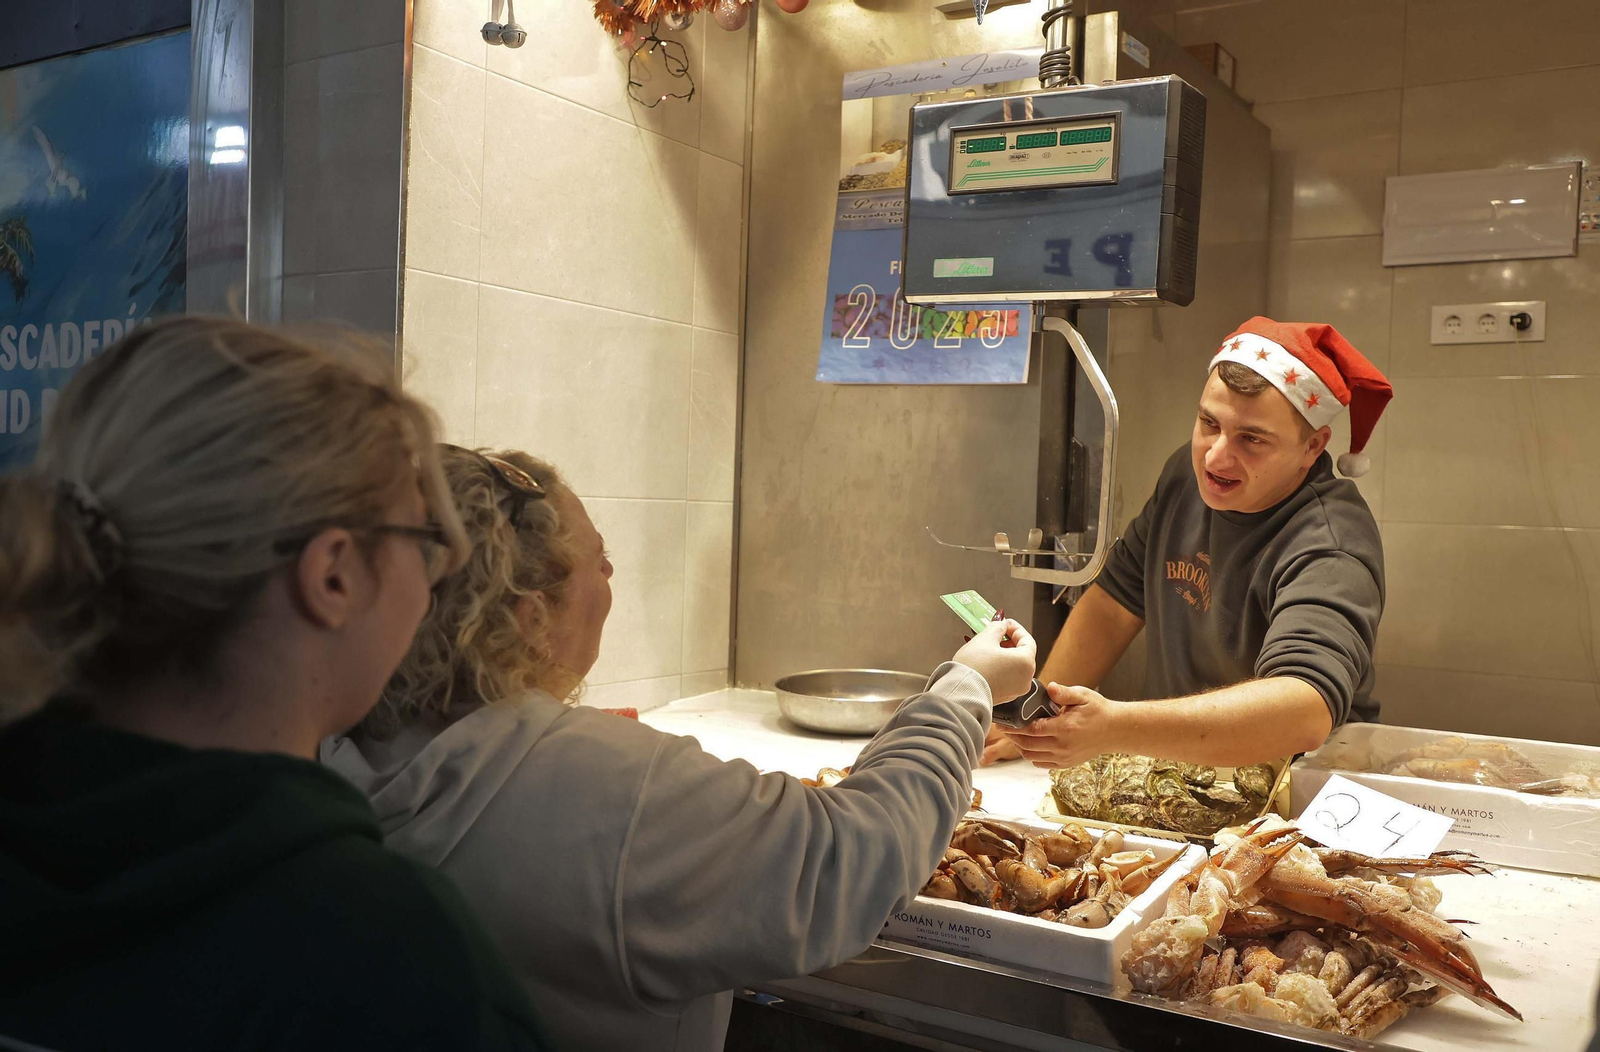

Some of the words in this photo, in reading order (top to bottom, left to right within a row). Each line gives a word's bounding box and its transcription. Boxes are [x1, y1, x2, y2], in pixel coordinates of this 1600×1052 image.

[1440, 806, 1447, 814] Y
[1450, 808, 1494, 819] MARTOS
[895, 913, 933, 927] ROMÁN
[937, 921, 944, 929] Y
[948, 922, 991, 938] MARTOS
[916, 927, 939, 936] CALIDAD
